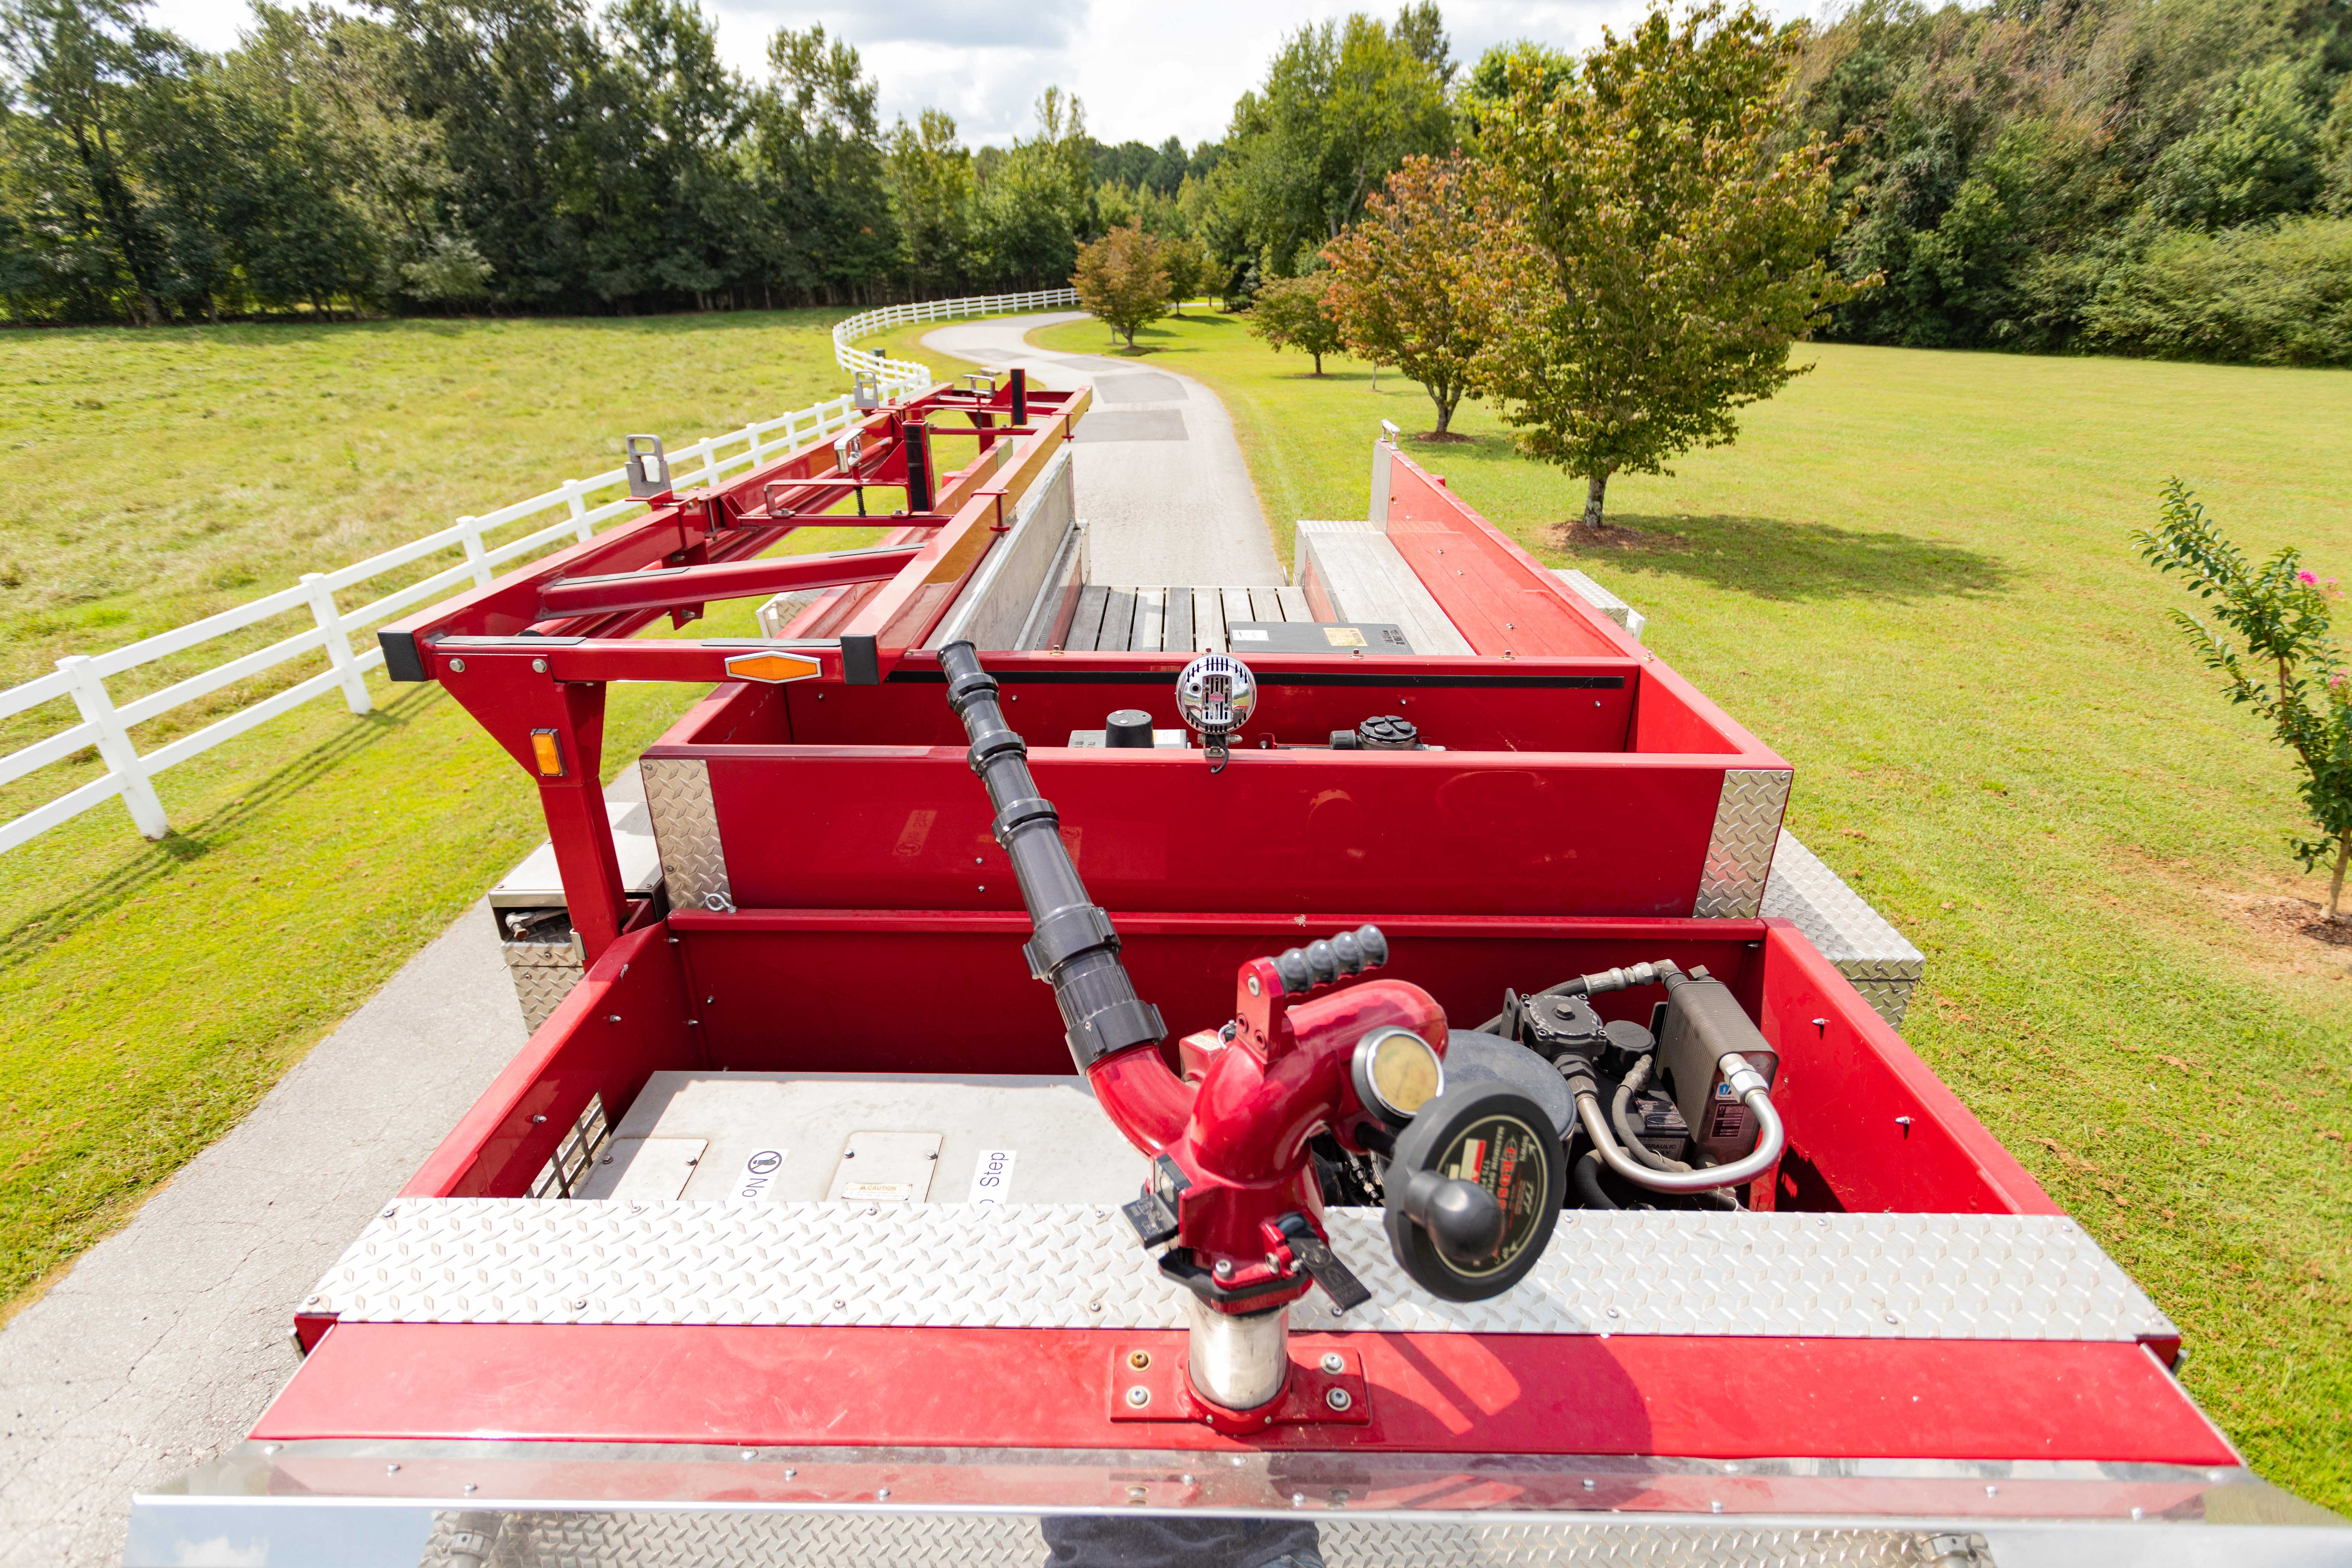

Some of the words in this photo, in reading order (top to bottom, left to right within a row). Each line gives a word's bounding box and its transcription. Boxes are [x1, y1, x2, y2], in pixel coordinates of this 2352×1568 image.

[1519, 1135, 1530, 1161] DOWN
[980, 1153, 1009, 1187] Step
[742, 1178, 768, 1197] No
